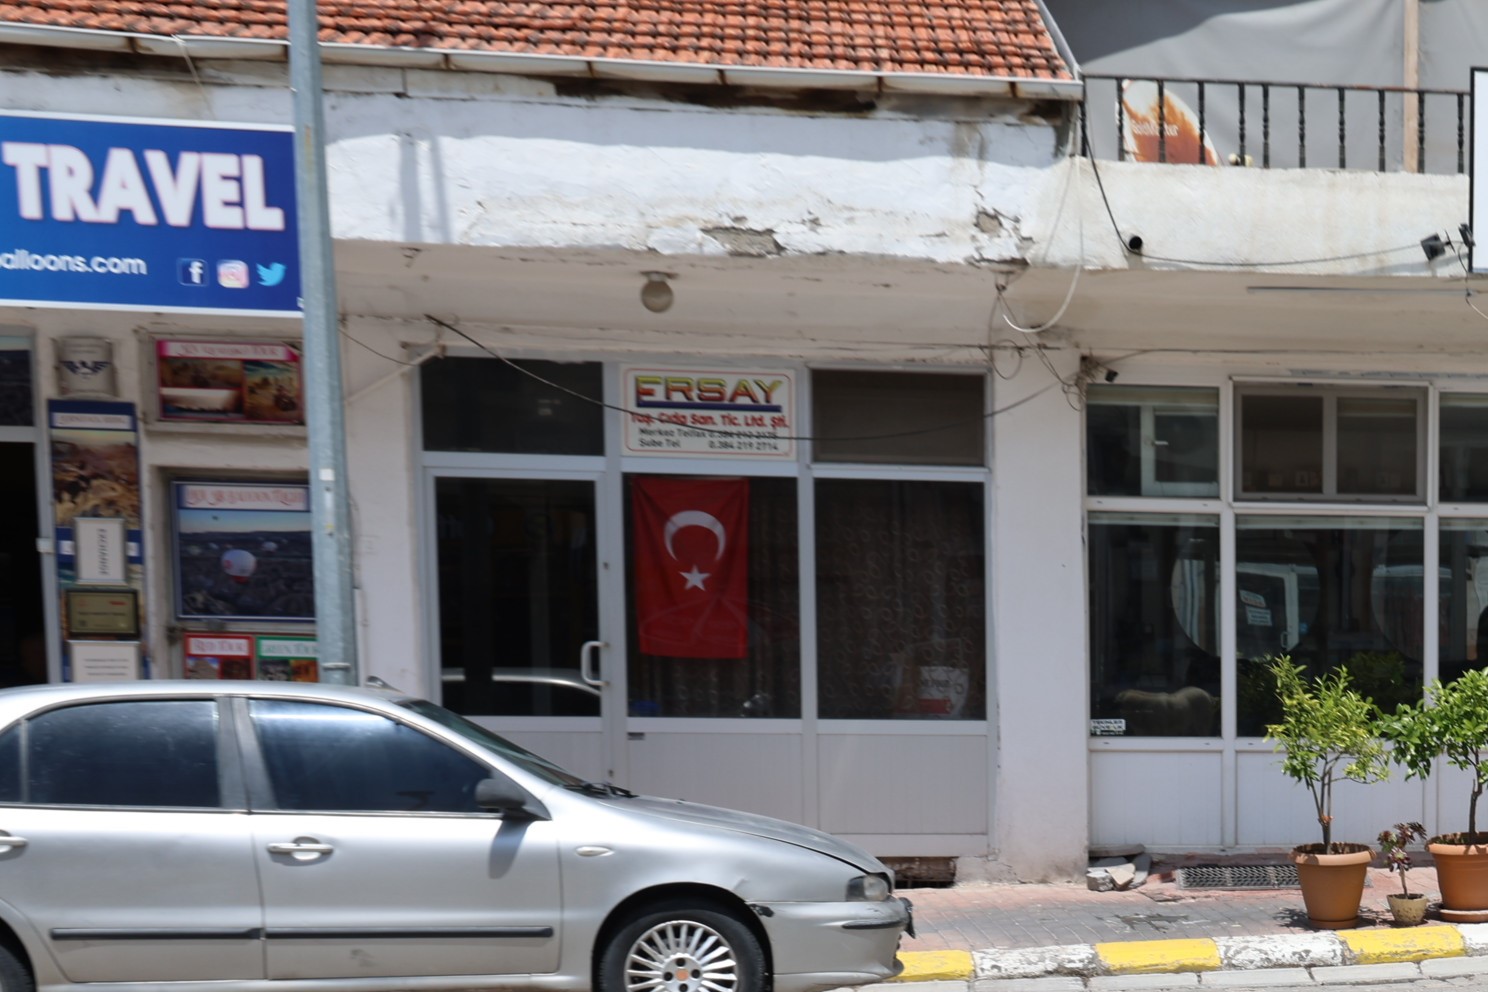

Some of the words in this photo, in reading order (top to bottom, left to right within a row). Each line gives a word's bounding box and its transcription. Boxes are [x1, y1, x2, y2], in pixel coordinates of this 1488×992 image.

[1, 142, 286, 231] TRAVEL
[0, 249, 148, 275] alloons.com
[635, 376, 783, 404] ERSAY
